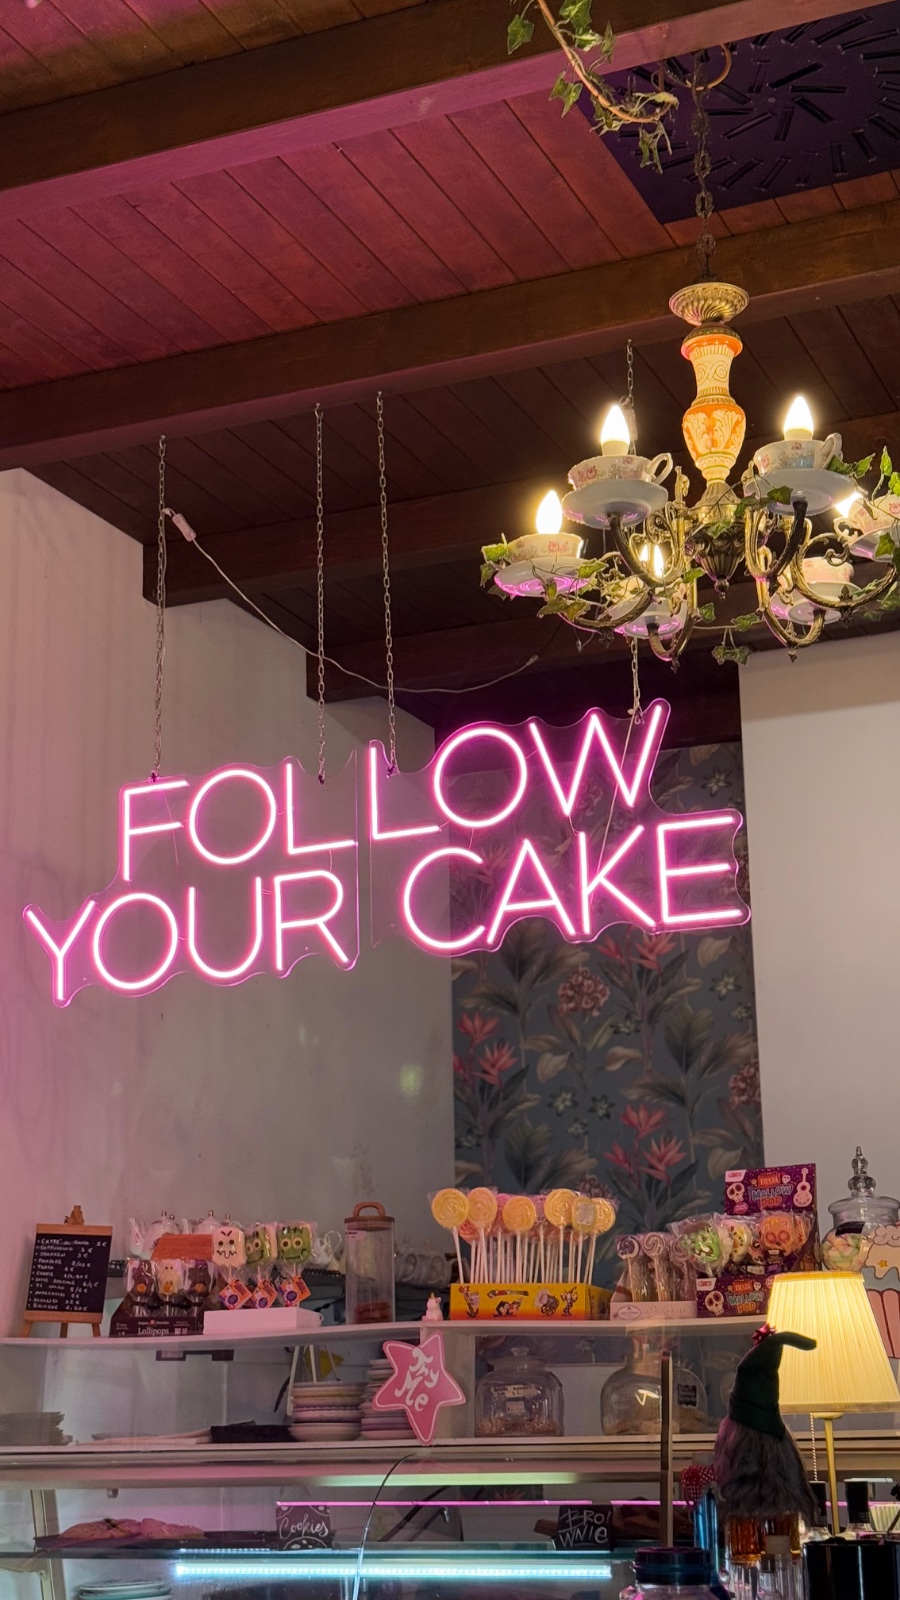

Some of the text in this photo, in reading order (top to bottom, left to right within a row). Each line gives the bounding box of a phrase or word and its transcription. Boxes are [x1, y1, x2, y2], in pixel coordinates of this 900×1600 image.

[403, 814, 744, 950] CAKE
[24, 869, 350, 1002] YOUR
[751, 1185, 793, 1201] MALLOW
[759, 1195, 783, 1208] POP
[727, 1292, 763, 1306] MALLOW
[737, 1302, 757, 1313] POP
[138, 1327, 170, 1336] Lollipops
[408, 1347, 440, 1388] Try
[394, 1370, 429, 1412] Me
[279, 1513, 329, 1540] Cookies
